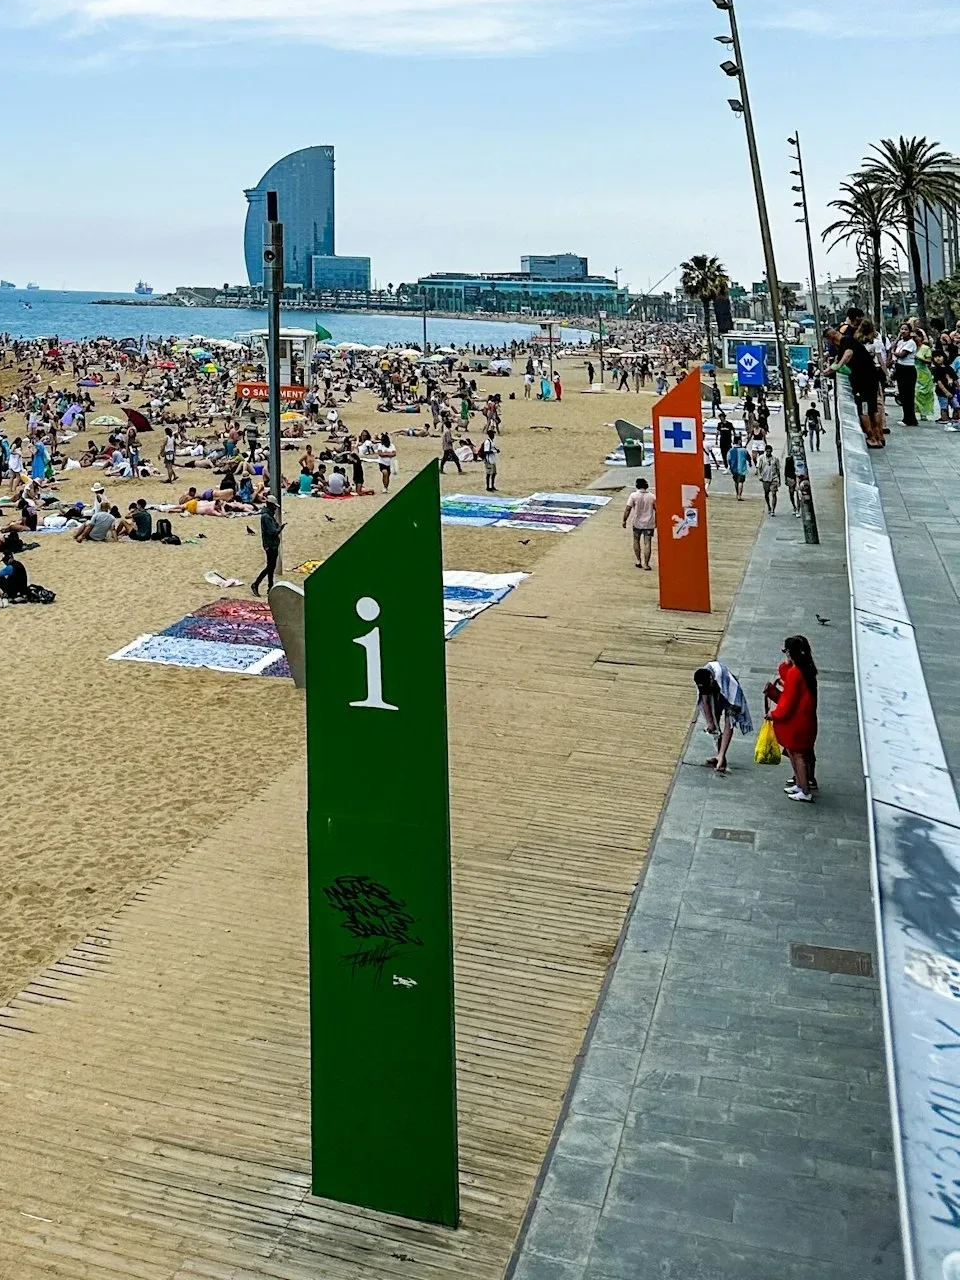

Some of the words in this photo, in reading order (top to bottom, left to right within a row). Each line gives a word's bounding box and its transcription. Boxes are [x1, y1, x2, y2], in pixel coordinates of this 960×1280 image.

[324, 148, 333, 157] W
[743, 358, 753, 366] W
[253, 389, 304, 398] SALMENT
[349, 596, 399, 711] i
